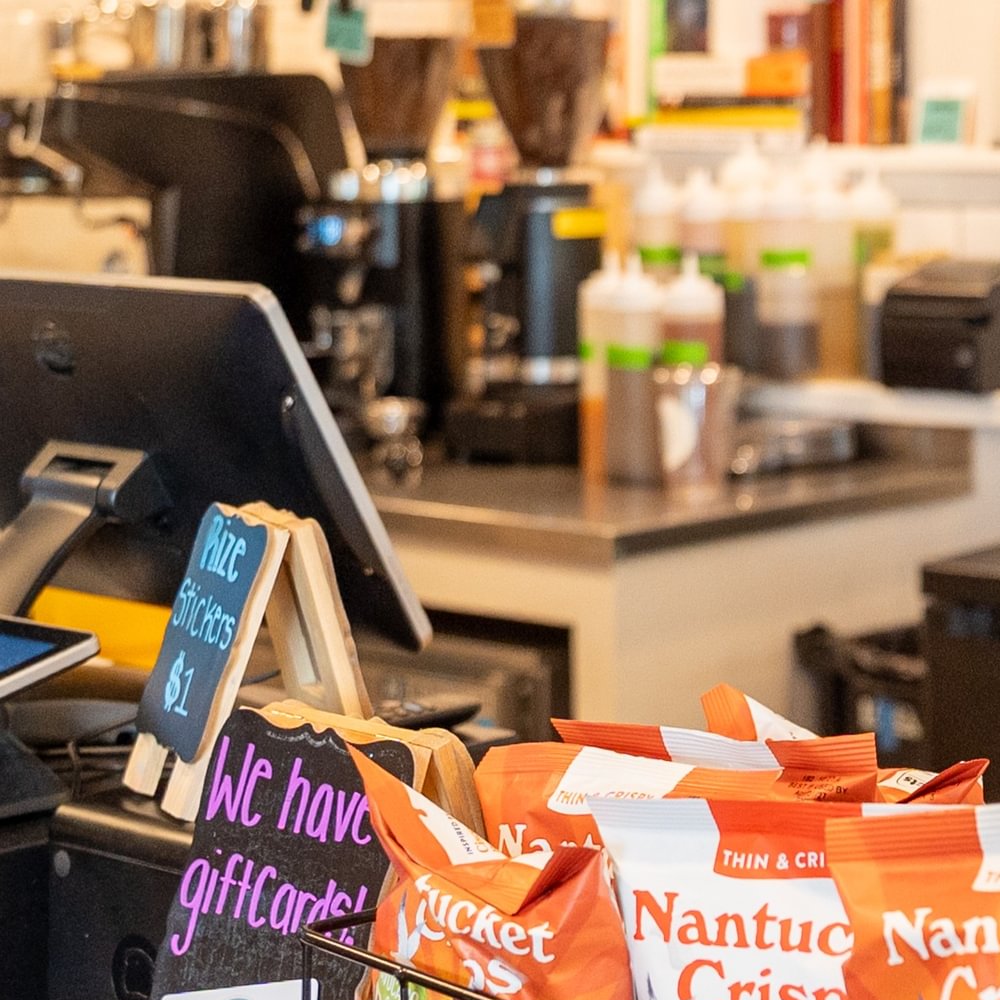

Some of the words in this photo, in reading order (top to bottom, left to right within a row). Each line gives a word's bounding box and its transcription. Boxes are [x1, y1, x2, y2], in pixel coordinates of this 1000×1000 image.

[164, 651, 195, 717] $1
[205, 735, 272, 828] We
[277, 757, 372, 845] have
[723, 850, 768, 869] THIN
[776, 853, 789, 870] &
